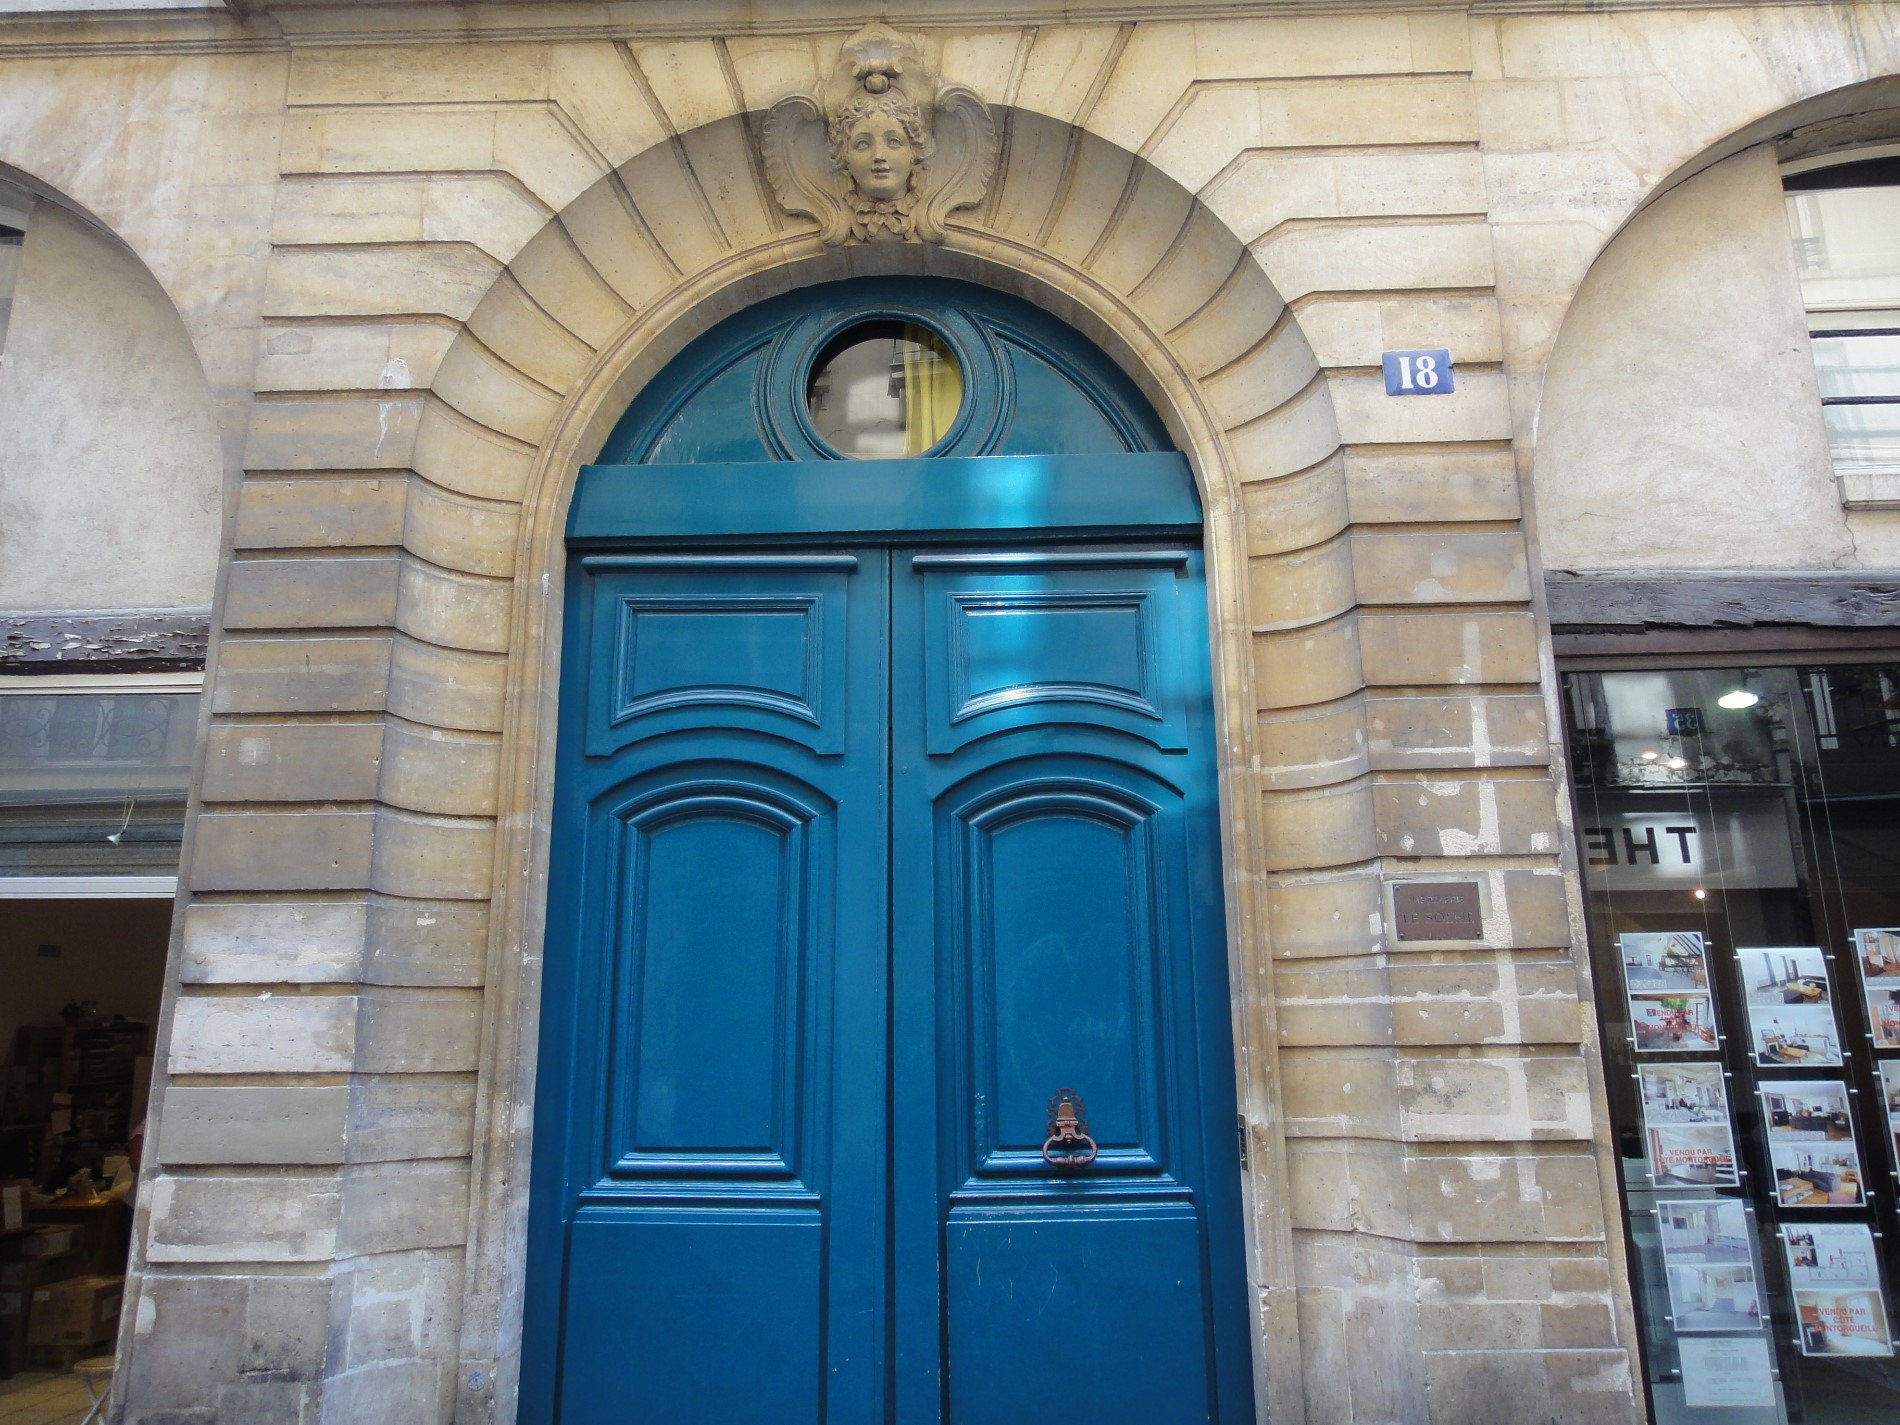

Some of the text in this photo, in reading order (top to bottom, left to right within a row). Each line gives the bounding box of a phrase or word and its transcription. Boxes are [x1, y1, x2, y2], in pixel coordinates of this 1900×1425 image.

[1398, 355, 1438, 389] 18
[1669, 1148, 1696, 1156] VENDU
[1819, 1307, 1866, 1316] VENDU PAR
